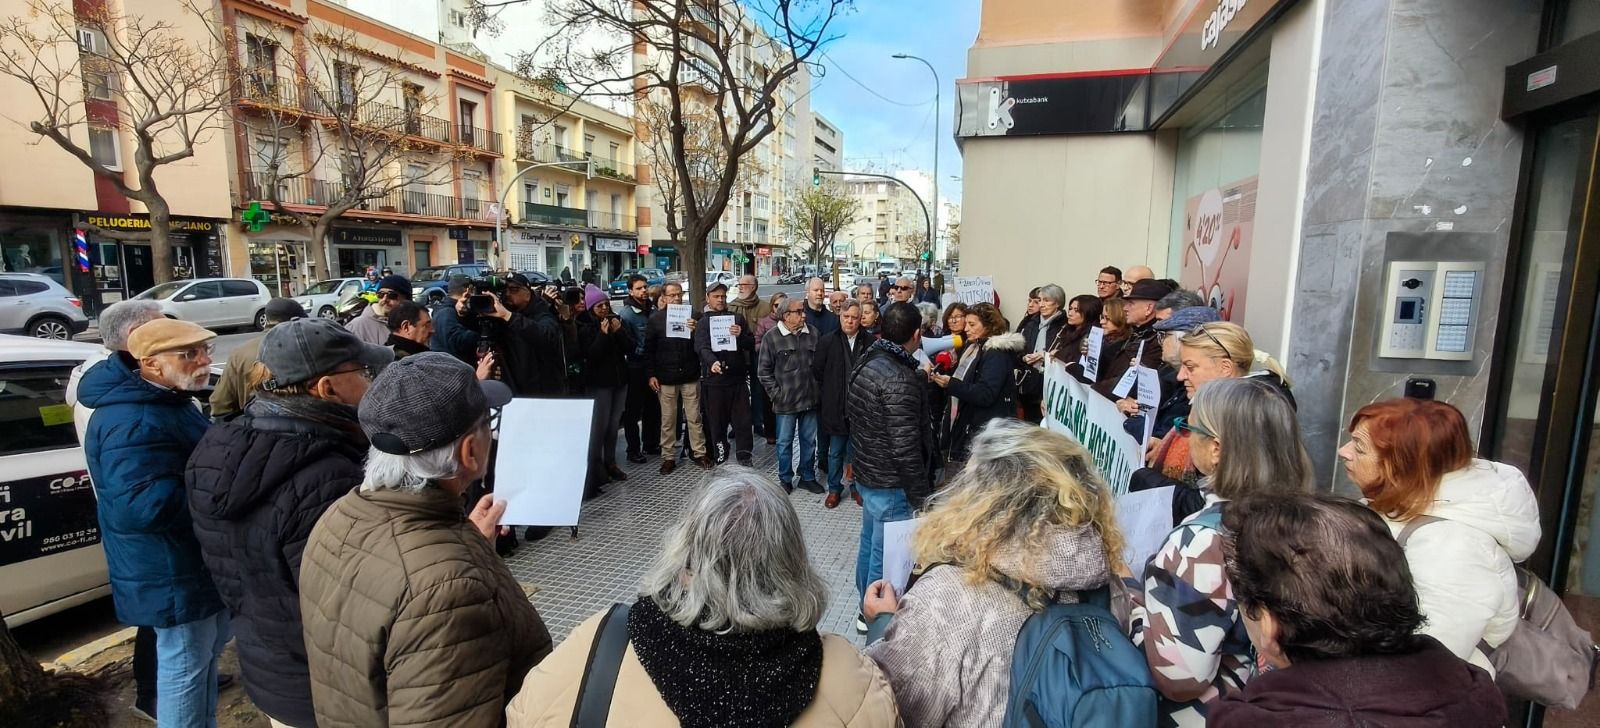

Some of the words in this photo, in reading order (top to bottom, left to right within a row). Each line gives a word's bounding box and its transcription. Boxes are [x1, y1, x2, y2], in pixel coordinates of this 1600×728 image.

[1201, 0, 1248, 50] cajas
[88, 216, 152, 228] PELUQERIA
[50, 474, 91, 490] CO-F
[76, 530, 85, 538] 12
[41, 535, 97, 552] www.co-fi.es
